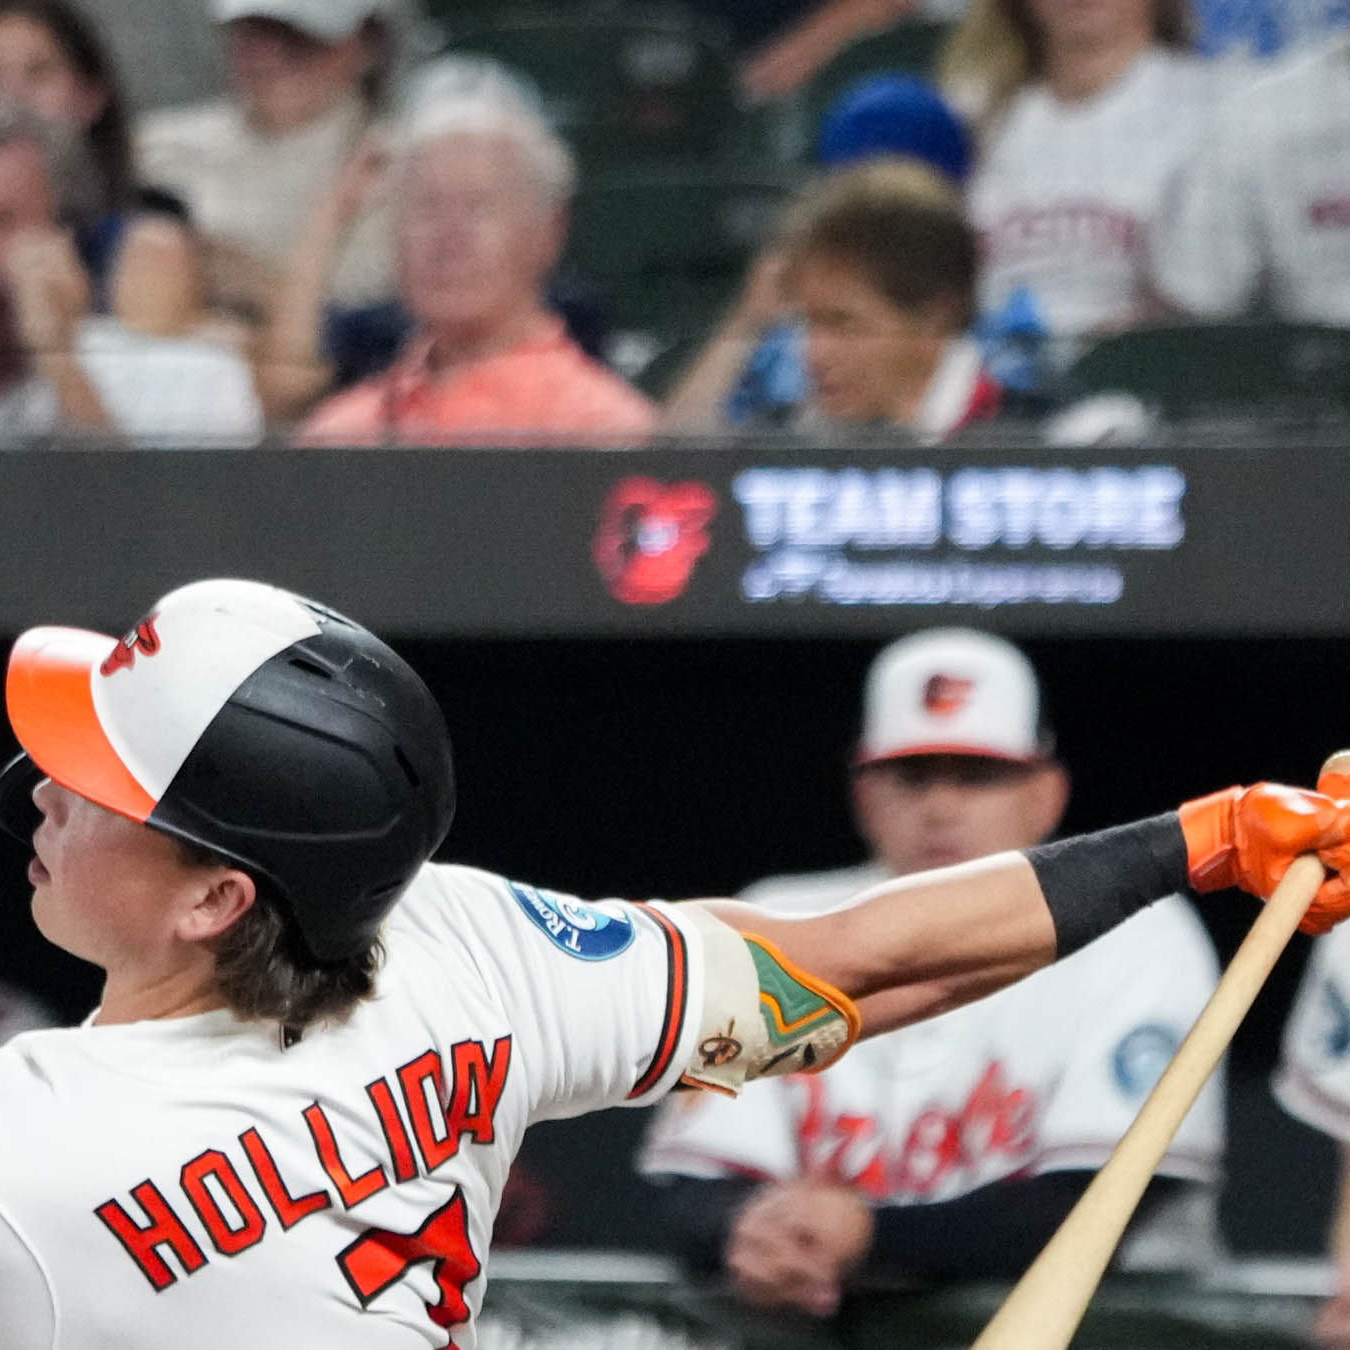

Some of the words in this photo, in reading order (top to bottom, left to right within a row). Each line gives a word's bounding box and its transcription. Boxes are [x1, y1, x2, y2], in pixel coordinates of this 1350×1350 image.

[733, 466, 944, 551] TEAM
[950, 466, 1187, 550] STORE
[93, 1033, 512, 1293] HOLLIDAY
